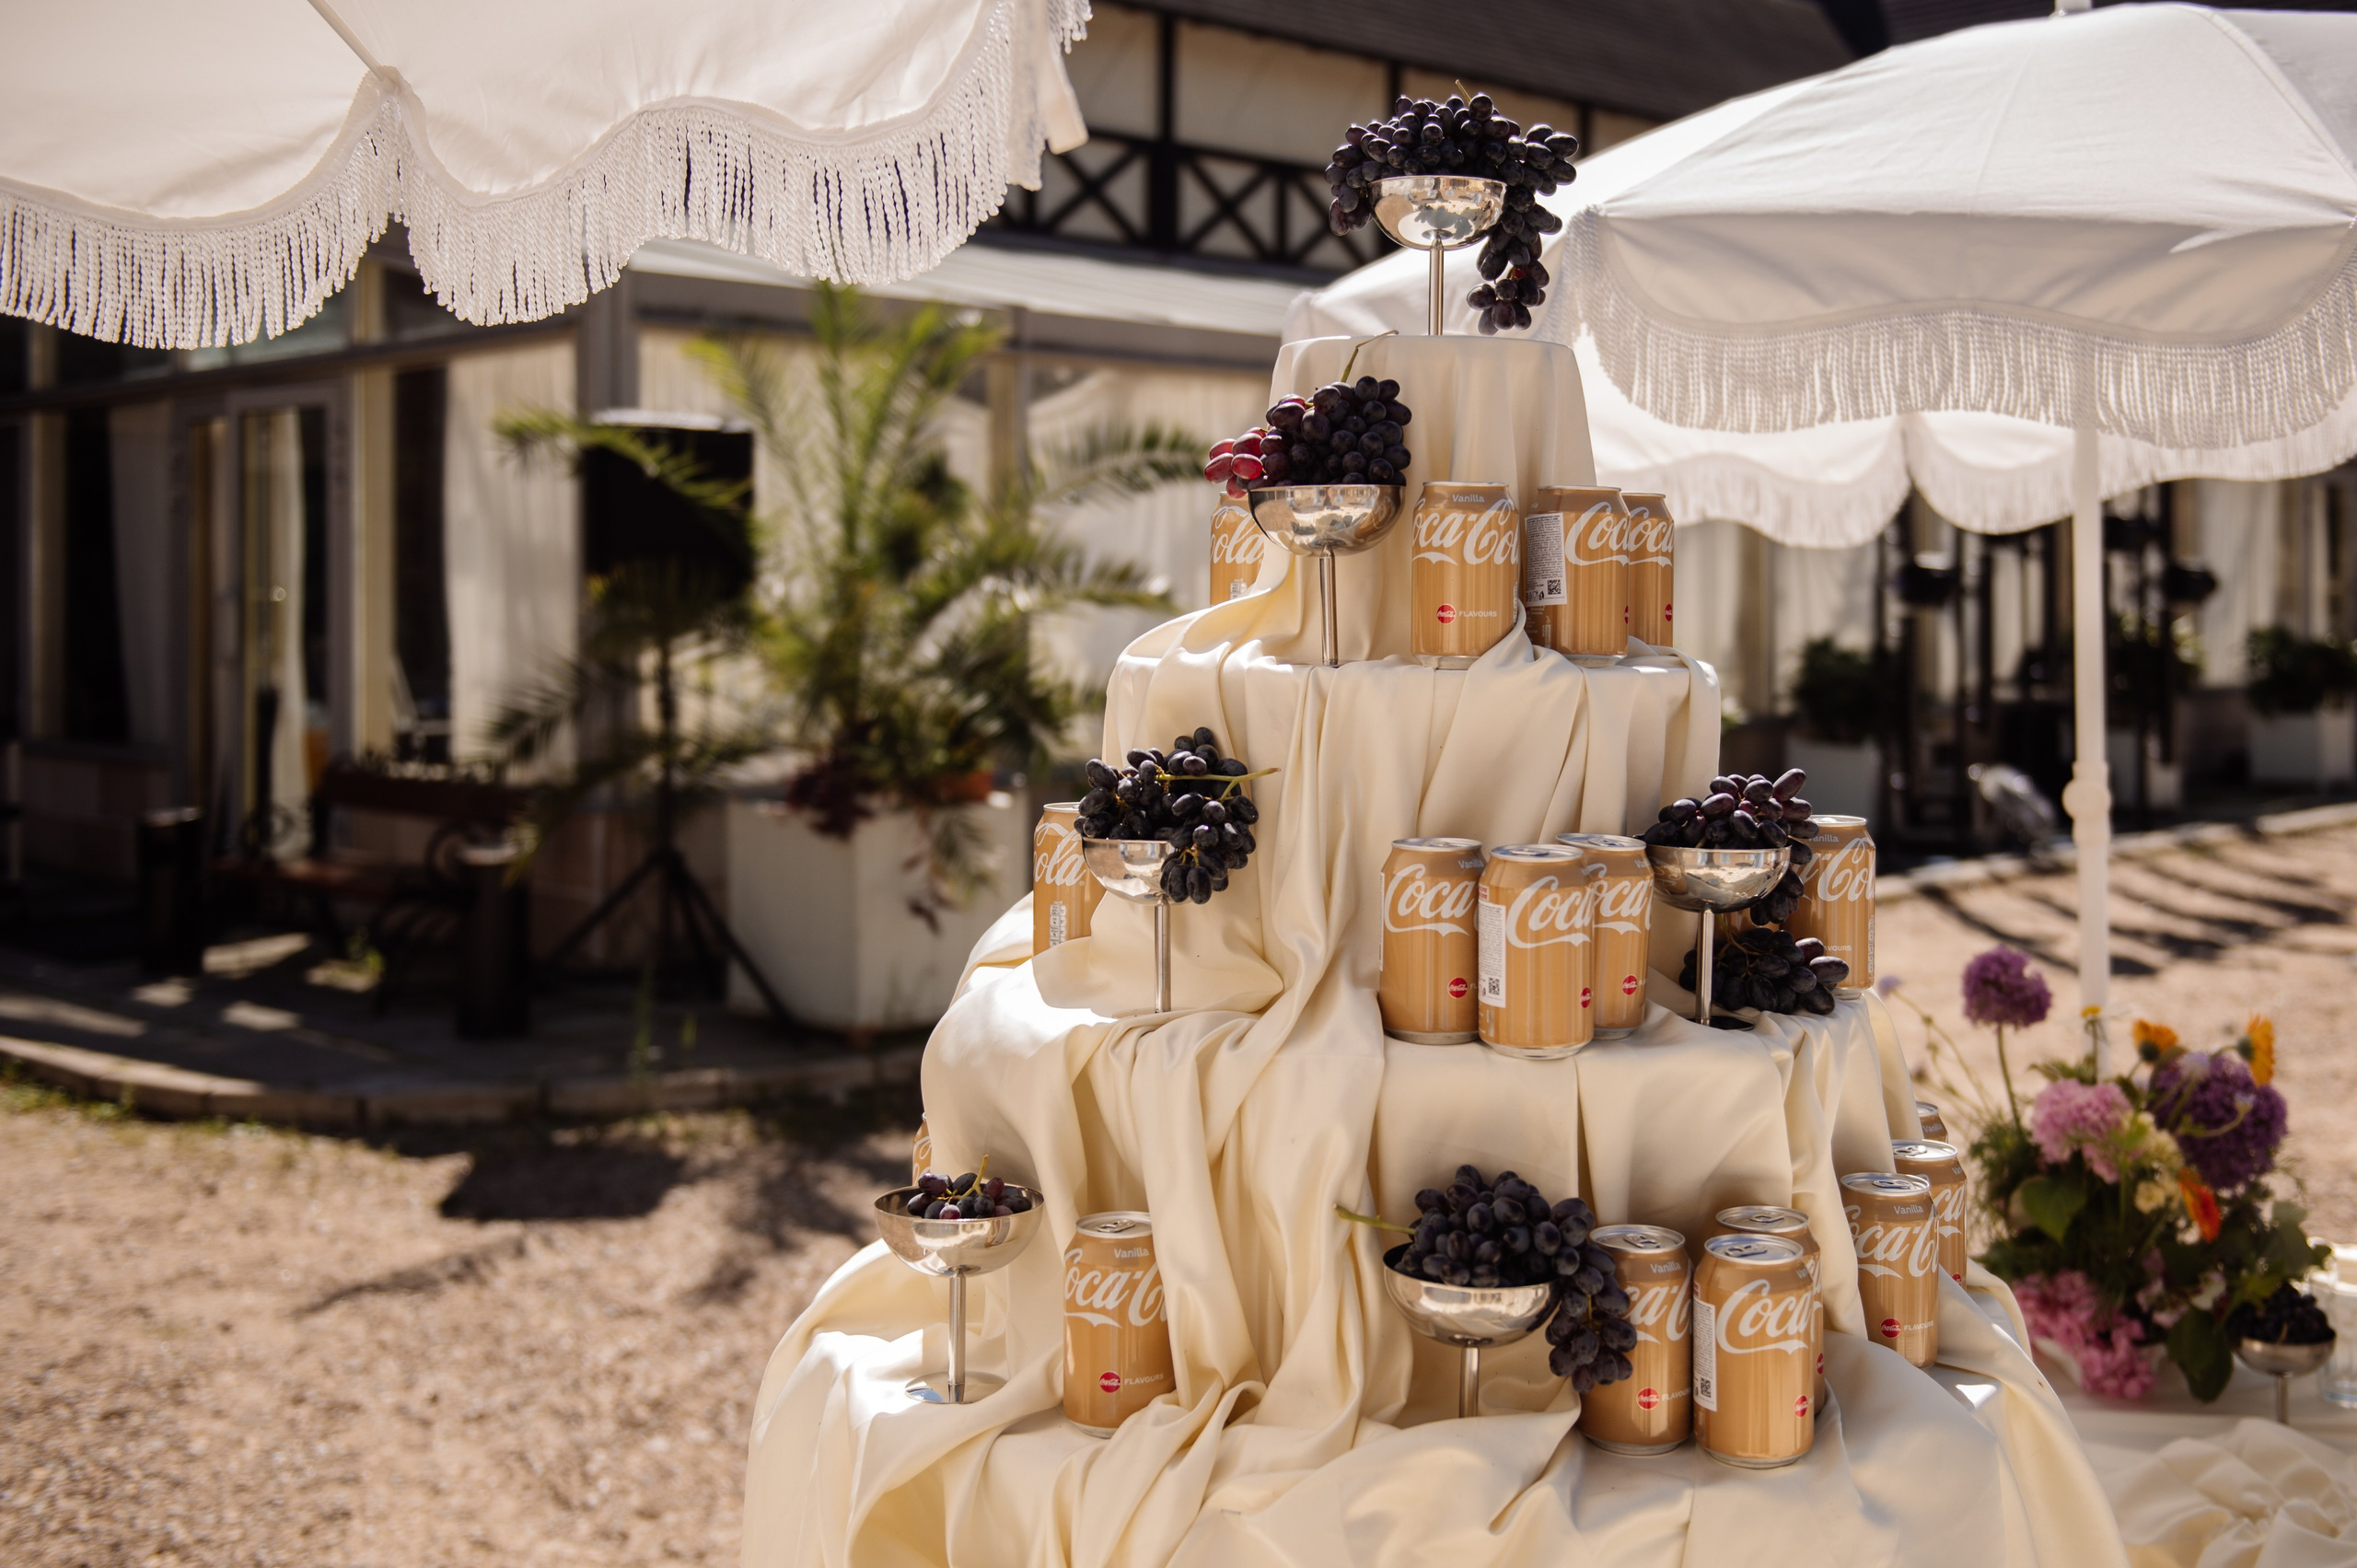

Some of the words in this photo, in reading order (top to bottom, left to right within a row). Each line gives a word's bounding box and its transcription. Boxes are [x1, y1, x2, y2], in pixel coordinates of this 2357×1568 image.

[1452, 494, 1485, 503] Vanilla
[1412, 498, 1519, 565] oca-Col
[1893, 1205, 1923, 1214] Vanilla
[1113, 1247, 1150, 1260] Vanilla
[1650, 1260, 1681, 1274] Vanilla
[1903, 1320, 1934, 1331] FLAVOURS
[1123, 1373, 1164, 1386] FLAVOURS
